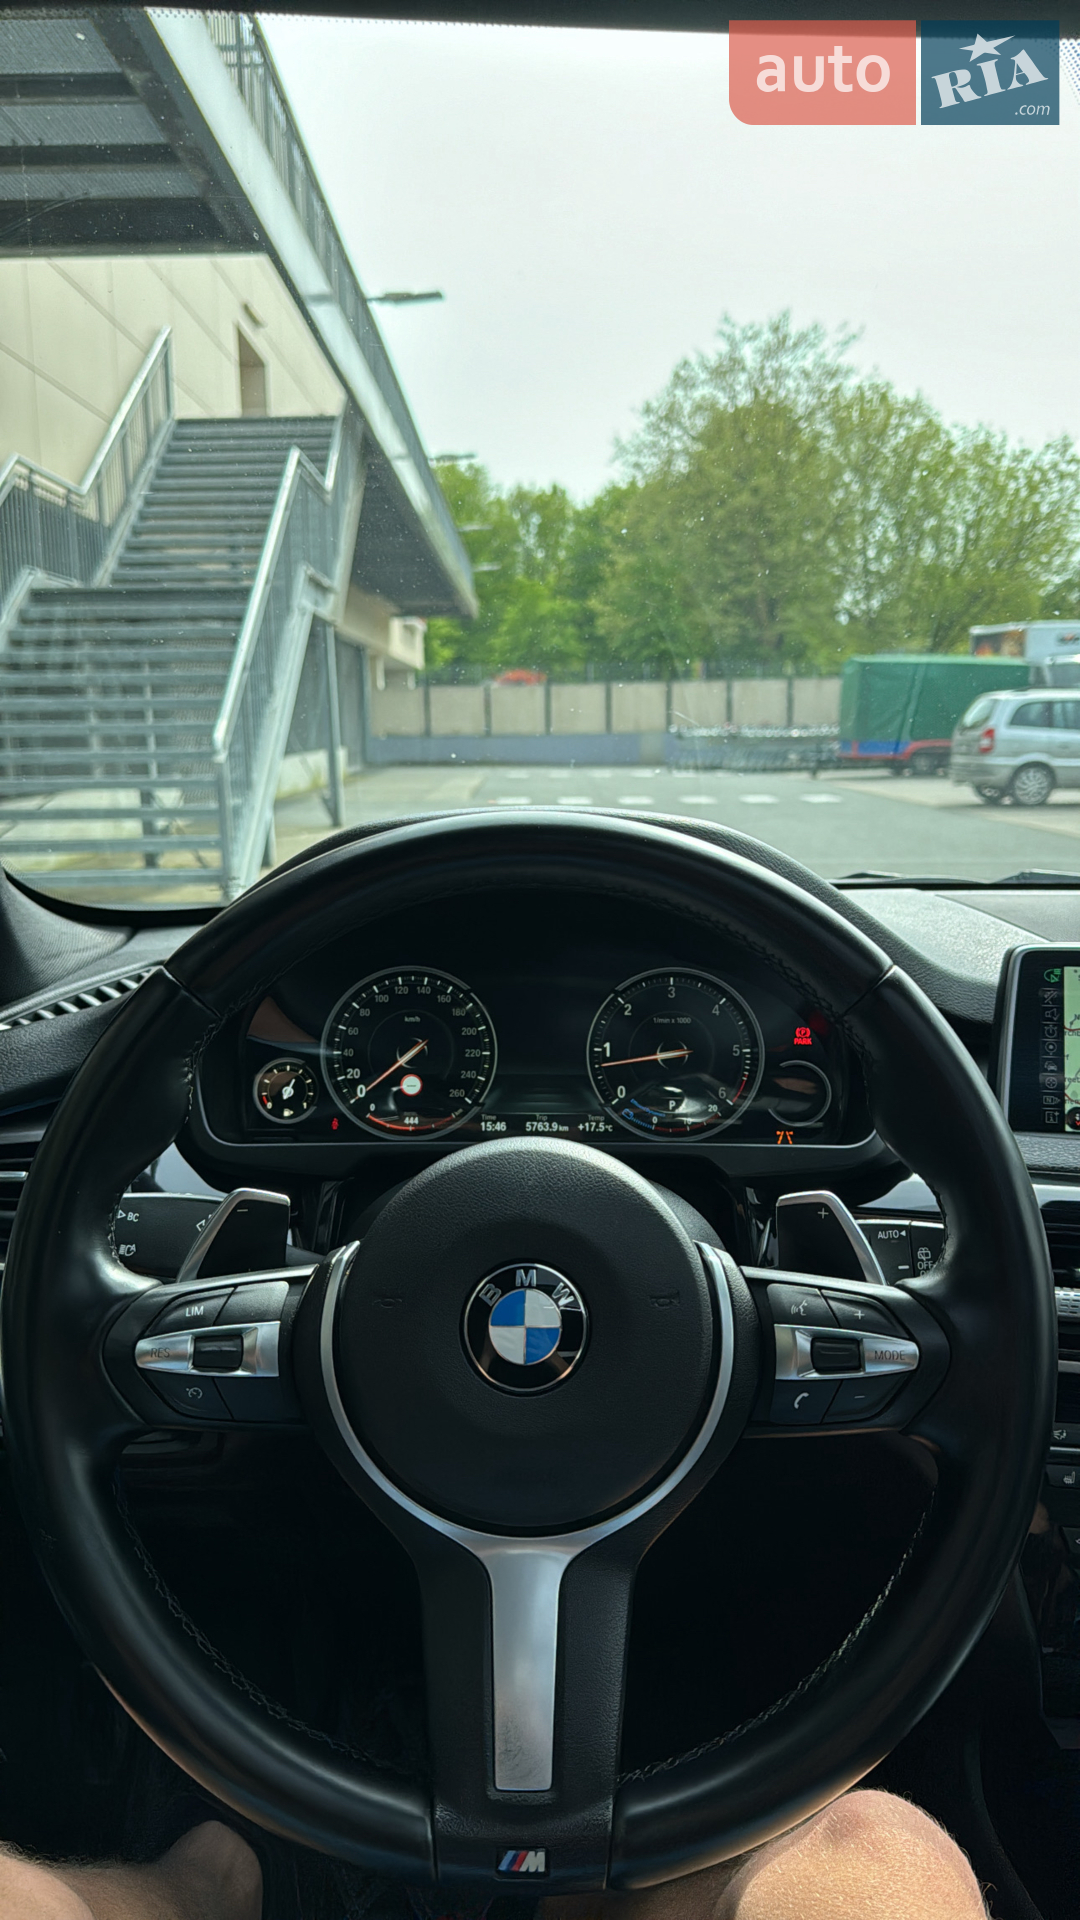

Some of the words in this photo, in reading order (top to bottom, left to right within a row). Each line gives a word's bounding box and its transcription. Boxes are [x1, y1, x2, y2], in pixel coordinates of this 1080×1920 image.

[394, 986, 409, 995] 120
[416, 986, 431, 995] 140
[667, 986, 676, 998] 3
[374, 995, 389, 1003] 100
[437, 995, 452, 1003] 160
[359, 1008, 370, 1017] 80
[452, 1008, 466, 1017] 180
[624, 1003, 632, 1016] 2
[712, 1004, 720, 1016] 4
[348, 1027, 359, 1036] 60
[461, 1027, 477, 1036] 200
[794, 1037, 812, 1045] PARK
[343, 1048, 354, 1057] 40
[465, 1049, 481, 1058] 220
[603, 1042, 611, 1057] 1
[732, 1044, 740, 1056] 5
[346, 1068, 361, 1079] 20
[460, 1071, 477, 1079] 240
[356, 1084, 366, 1098] 0
[449, 1089, 465, 1098] 260
[617, 1085, 626, 1098] 0
[718, 1087, 726, 1099] 6
[266, 1101, 273, 1109] 0
[369, 1103, 376, 1112] 0
[669, 1101, 676, 1110] P
[707, 1104, 718, 1112] 20
[403, 1116, 419, 1125] 444
[535, 1114, 548, 1122] Trip
[588, 1114, 605, 1122] Temp
[652, 1116, 658, 1124] 0
[480, 1121, 507, 1132] 15:46
[525, 1121, 558, 1132] 5763.9
[558, 1124, 569, 1132] km
[127, 1211, 140, 1222] BC
[877, 1230, 900, 1240] AUTO
[917, 1261, 933, 1270] OFF
[479, 1269, 575, 1307] BMW
[185, 1305, 204, 1317] LIM
[150, 1348, 170, 1358] RES
[874, 1350, 906, 1361] MODE
[519, 1850, 546, 1872] M
